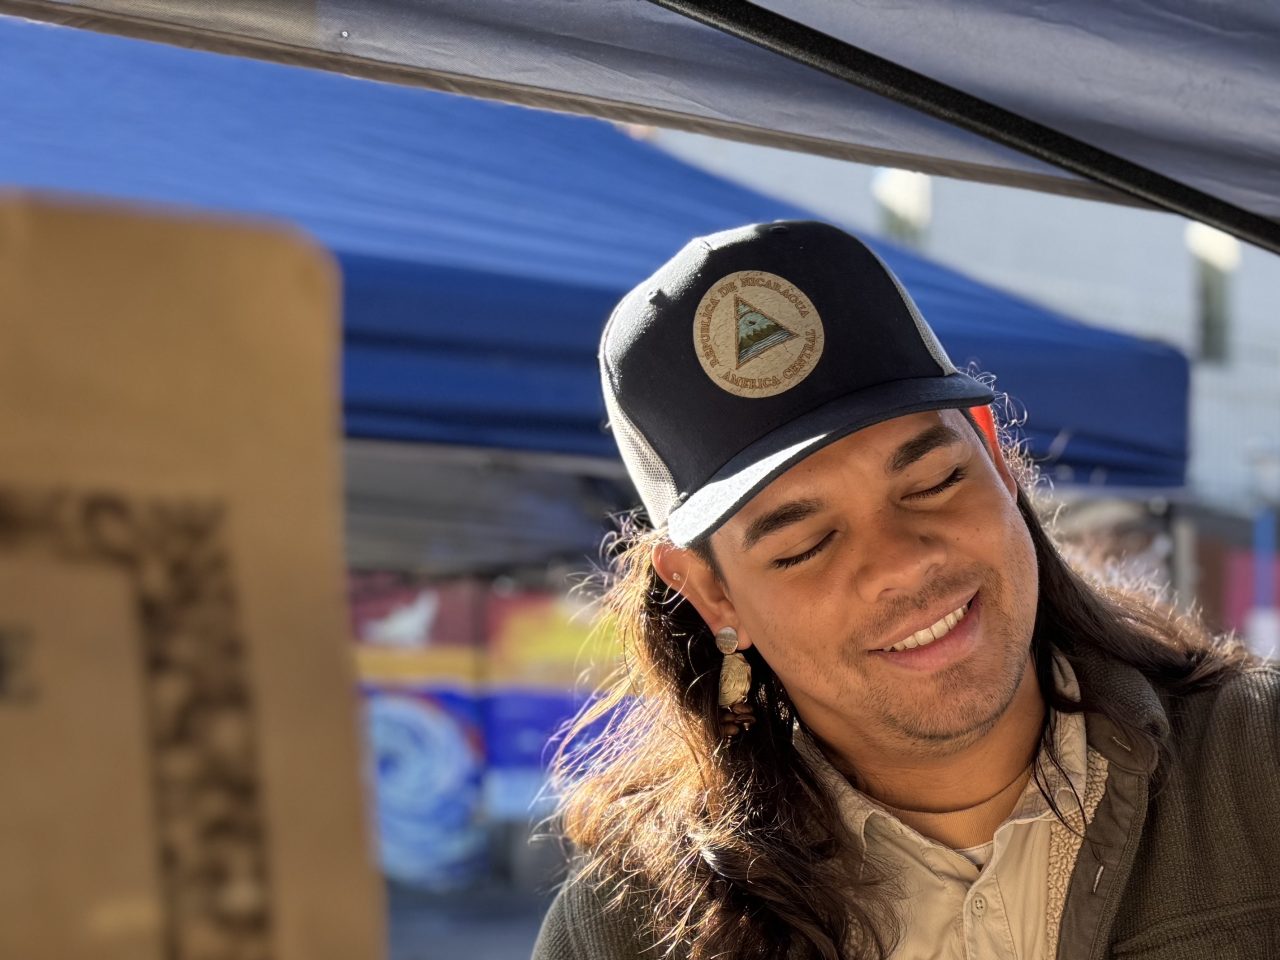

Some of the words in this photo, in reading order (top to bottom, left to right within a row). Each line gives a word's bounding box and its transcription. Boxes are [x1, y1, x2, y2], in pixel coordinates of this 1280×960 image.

[741, 277, 810, 318] NICARAGUA
[722, 370, 781, 390] AMERICA
[783, 328, 817, 380] CENTRAL
